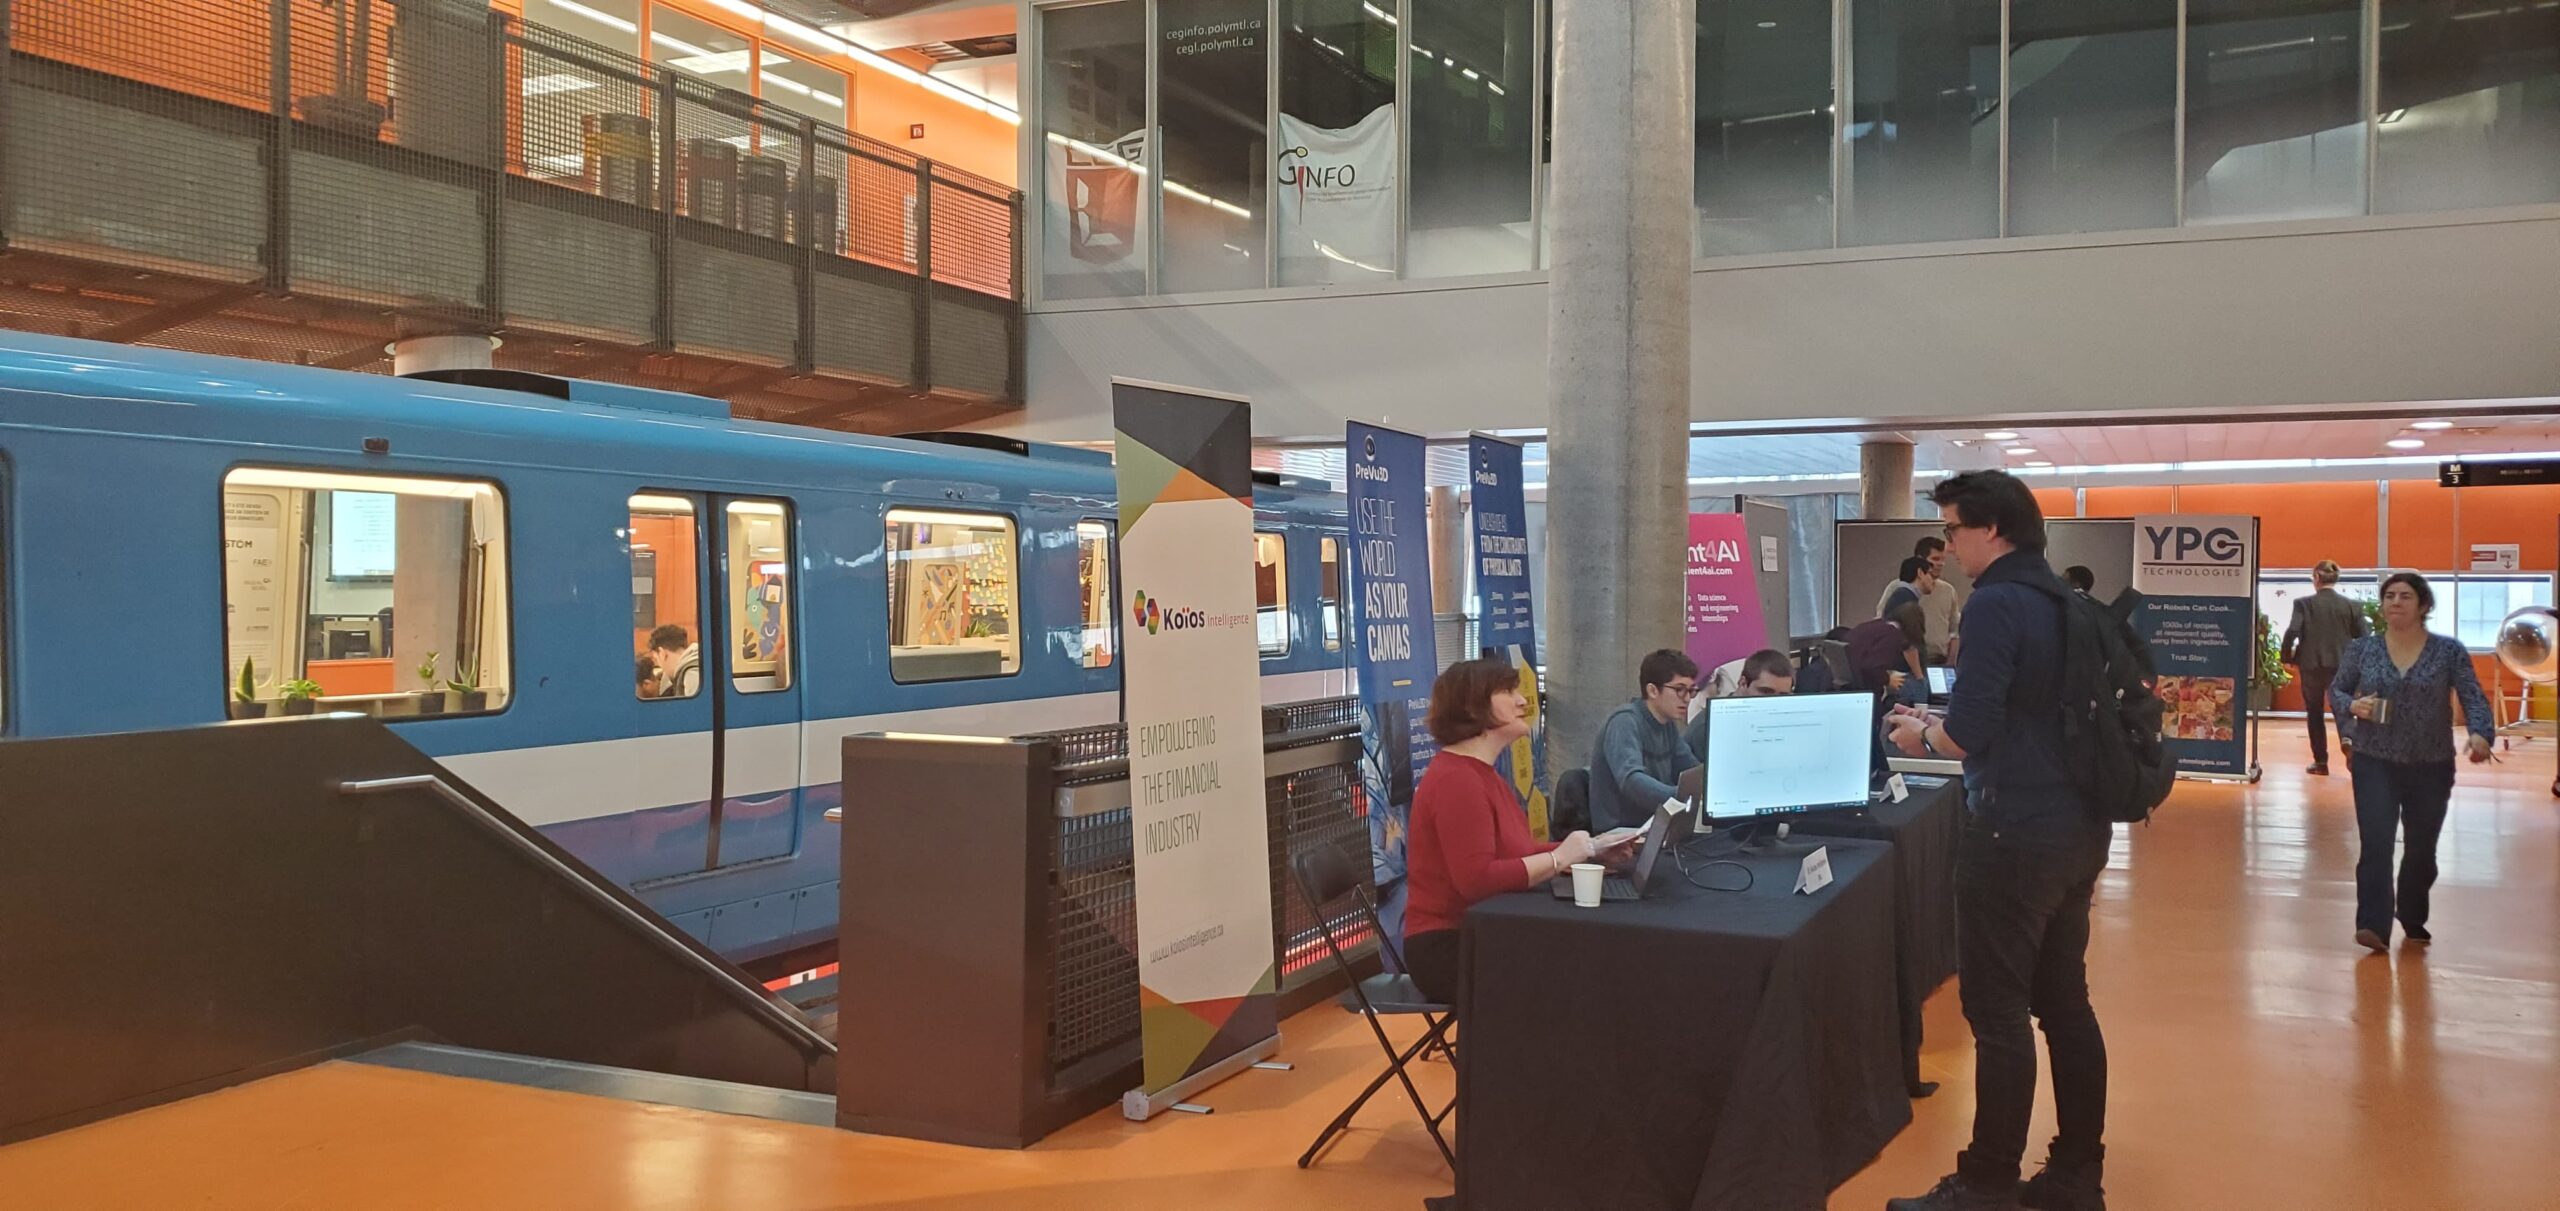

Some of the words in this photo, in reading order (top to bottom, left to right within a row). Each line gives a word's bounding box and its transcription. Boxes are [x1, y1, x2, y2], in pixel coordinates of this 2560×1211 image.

[1166, 19, 1261, 40] ceginfo.polymtl.ca
[1355, 463, 1389, 482] PreVu3D
[2450, 464, 2461, 472] M
[2452, 475, 2459, 484] 3
[1355, 496, 1379, 535] USE
[1379, 499, 1397, 537] THE
[225, 539, 253, 549] STOM
[1687, 540, 1741, 562] nt4AI
[1359, 539, 1396, 576] WORLD
[1687, 566, 1733, 576] ient4ai.com
[2143, 567, 2241, 577] TECHNOLOGIES
[1365, 581, 1382, 619] AS
[1381, 582, 1409, 619] YOUR
[1163, 606, 1205, 631] Koïos
[1367, 623, 1411, 662] CANVAS
[2171, 653, 2187, 661] True
[1140, 714, 1216, 758] EMPOWERING
[1142, 771, 1164, 807] THE
[1166, 760, 1222, 801] FINANCIAL
[1145, 811, 1201, 856] INDUSTRY
